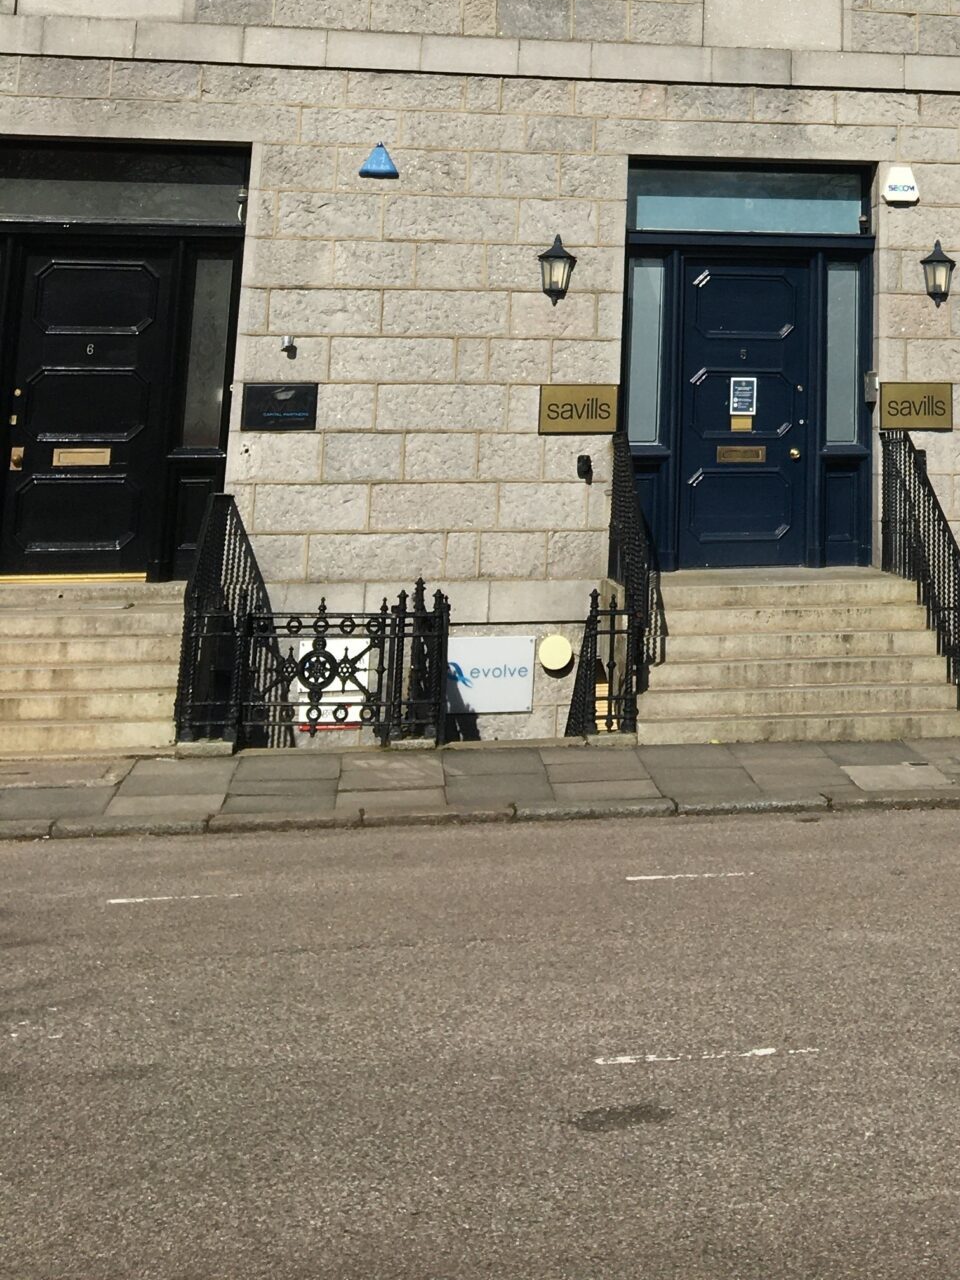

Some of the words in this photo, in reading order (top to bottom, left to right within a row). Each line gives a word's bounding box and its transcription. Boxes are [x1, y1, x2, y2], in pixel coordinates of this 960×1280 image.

[888, 184, 915, 192] SECOM
[86, 343, 95, 356] 6
[547, 398, 611, 420] savills
[887, 395, 946, 417] savills
[470, 664, 529, 679] evolve
